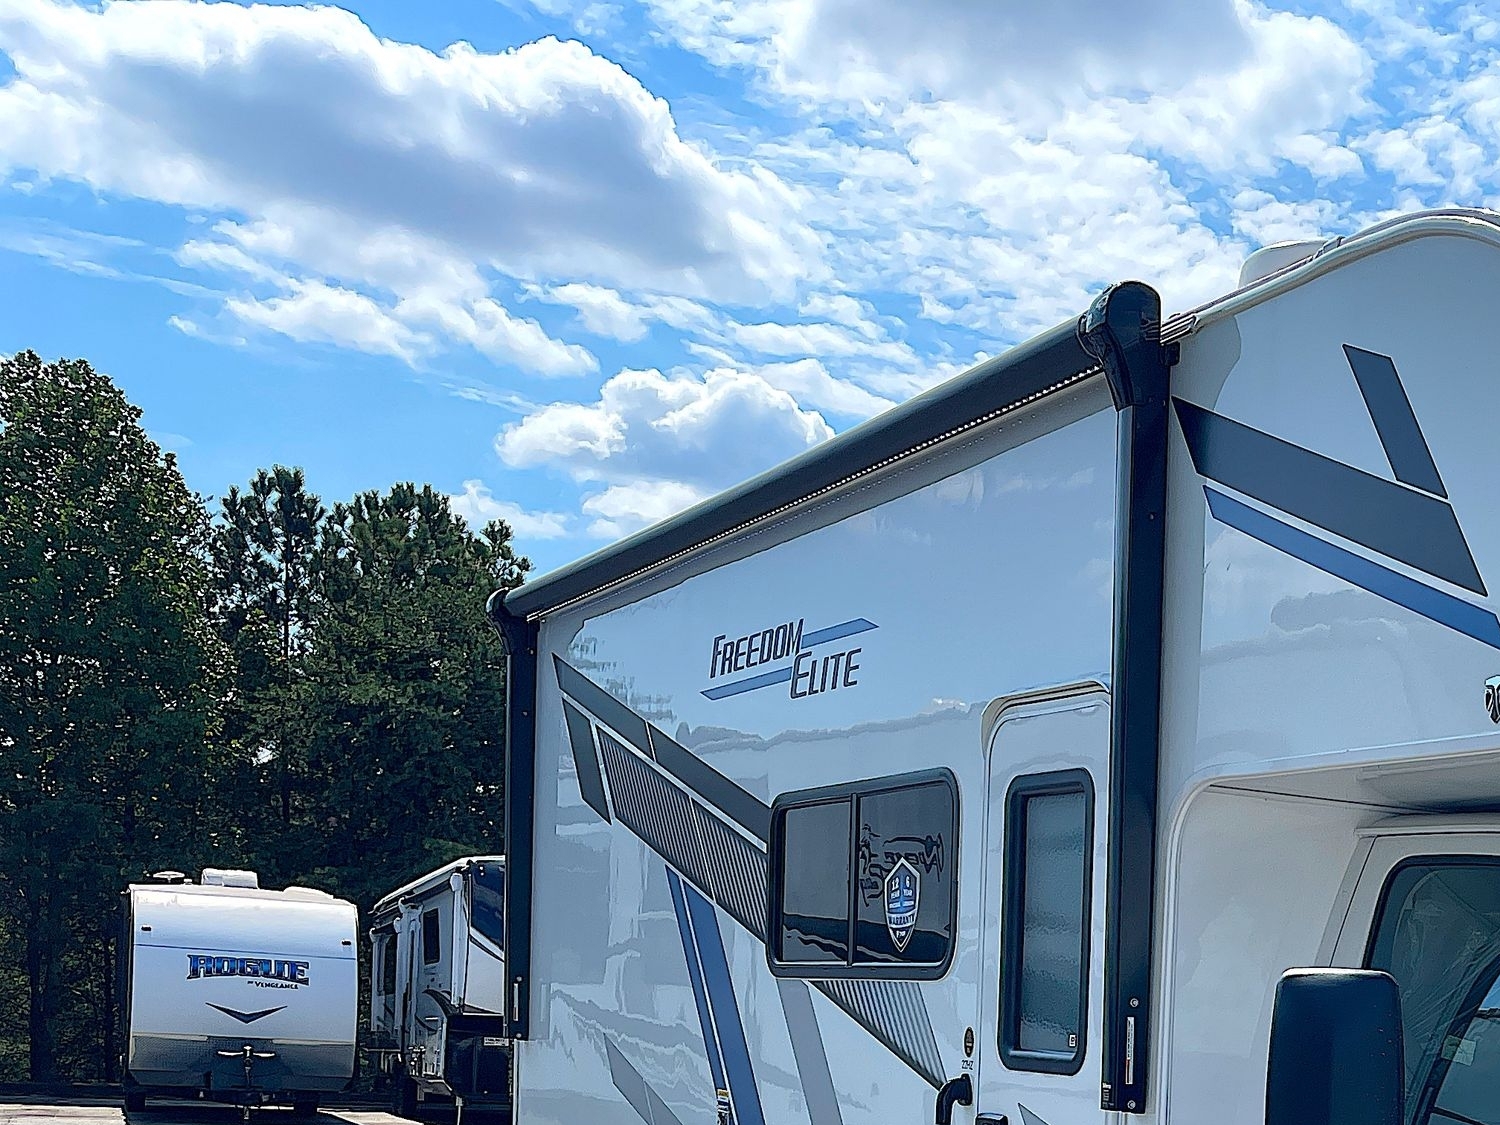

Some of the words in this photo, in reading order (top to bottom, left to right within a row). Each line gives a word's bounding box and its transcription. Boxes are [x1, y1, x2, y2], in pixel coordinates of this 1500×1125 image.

[709, 617, 805, 679] FREEDOM
[789, 647, 863, 700] ELITE
[891, 877, 900, 891] 12
[186, 954, 310, 986] ROGUE
